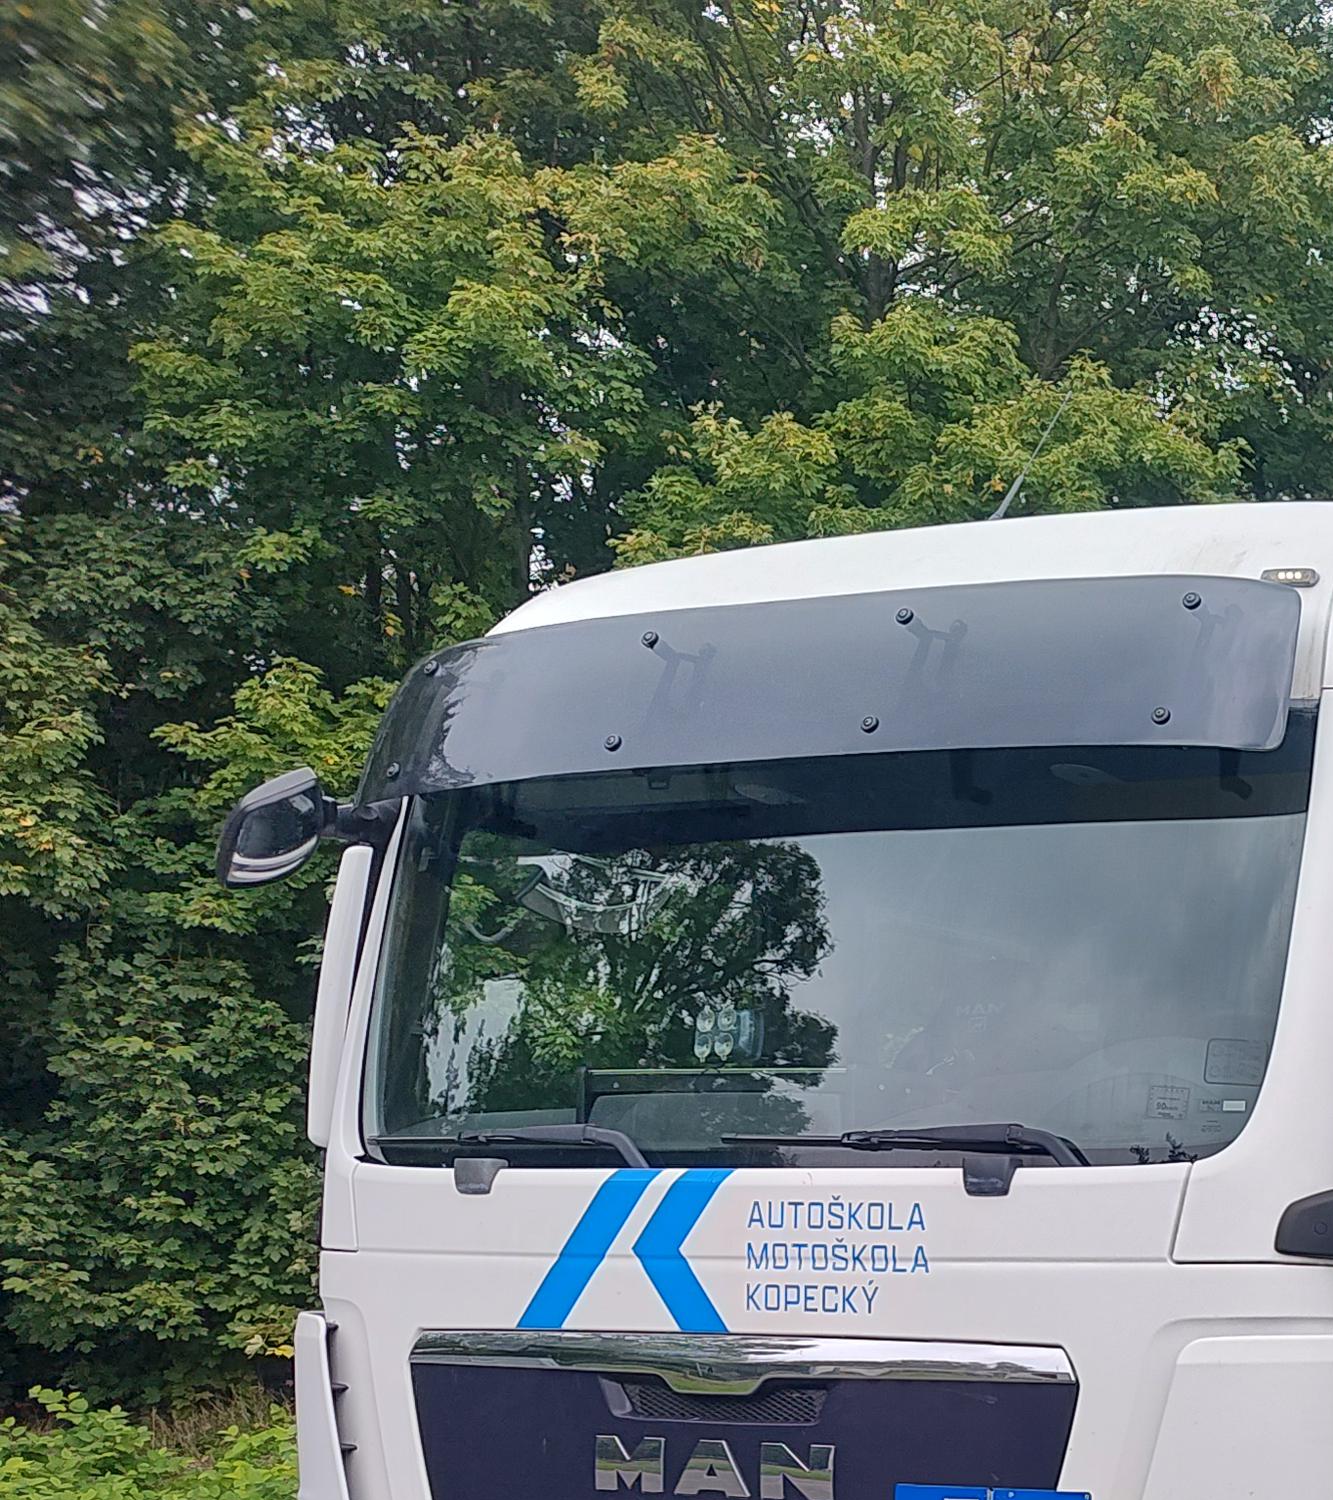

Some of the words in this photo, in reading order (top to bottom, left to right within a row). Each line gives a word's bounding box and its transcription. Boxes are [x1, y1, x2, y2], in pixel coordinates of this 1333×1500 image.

[747, 1195, 926, 1231] AUTOŠKOLA
[746, 1238, 930, 1274] MOTOŠKOLA
[746, 1280, 879, 1314] KOPECKÝ
